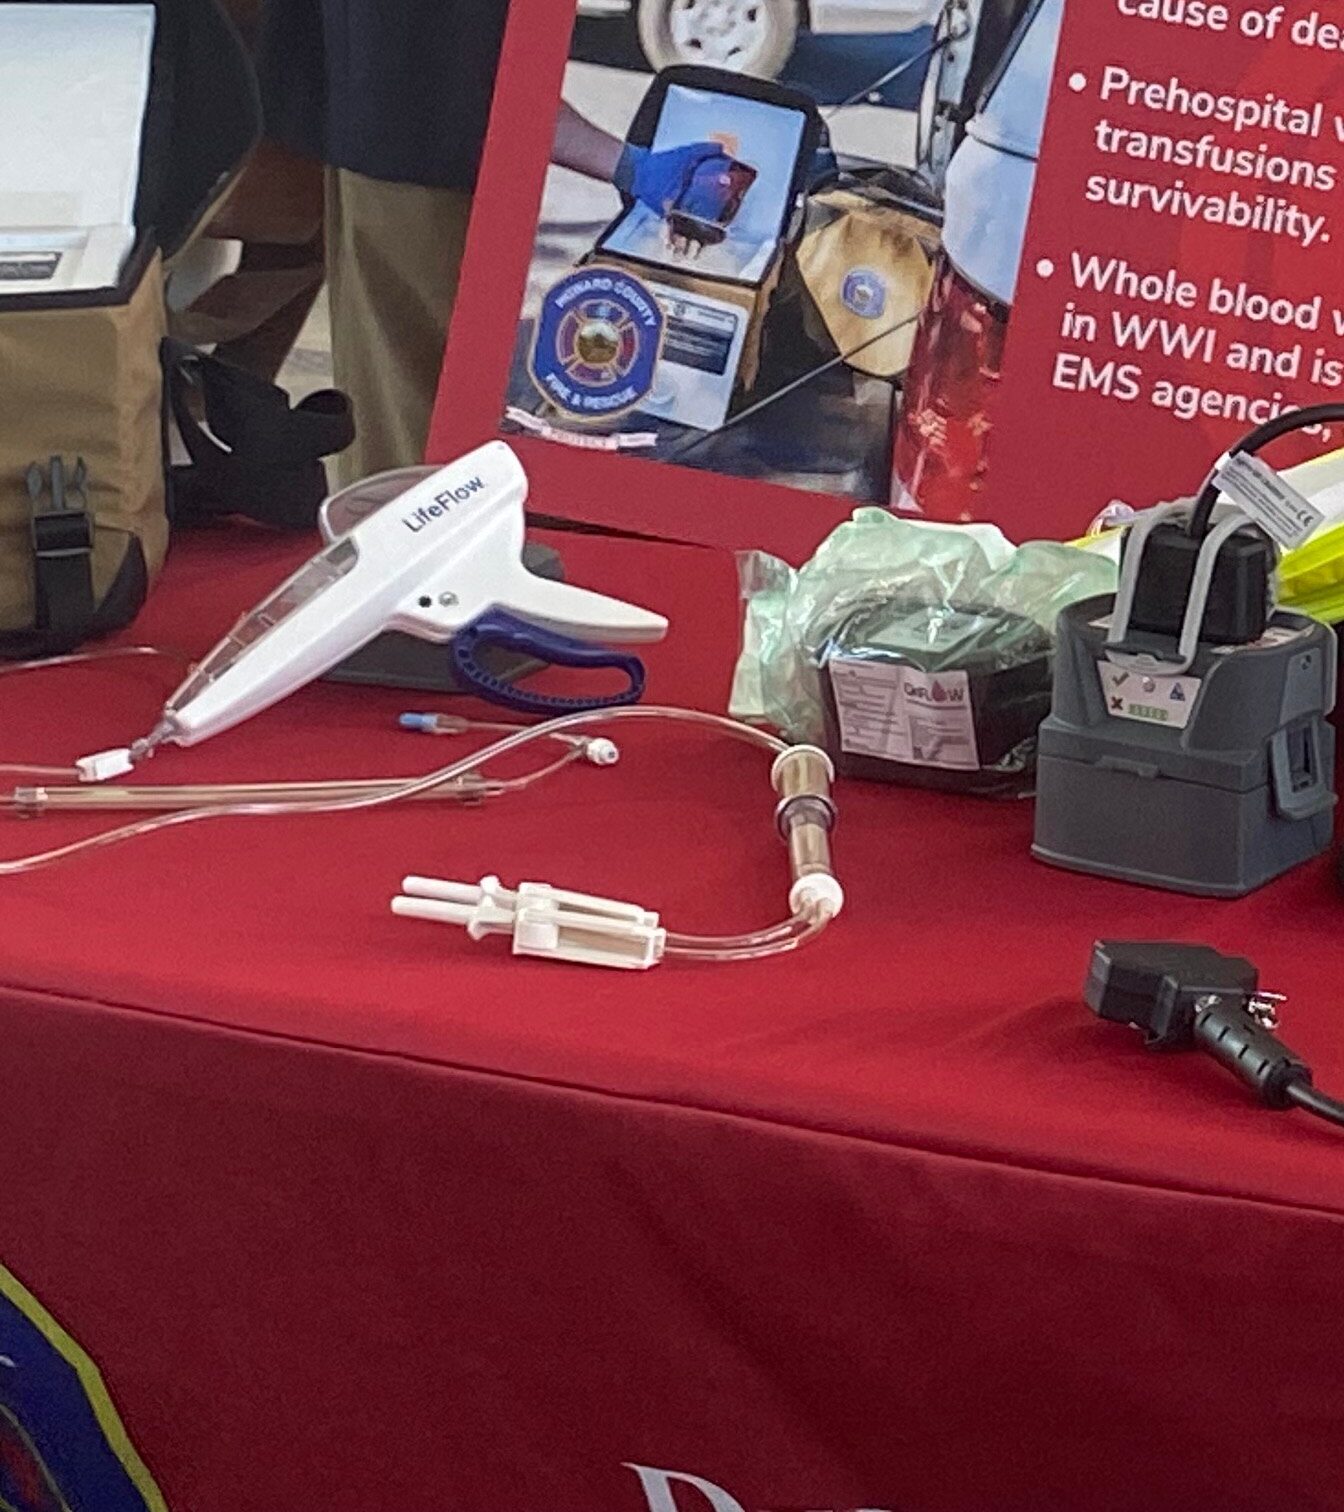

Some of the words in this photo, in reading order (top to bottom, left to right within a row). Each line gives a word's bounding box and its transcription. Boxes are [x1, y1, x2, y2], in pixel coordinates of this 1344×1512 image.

[1241, 6, 1284, 38] of
[1101, 67, 1322, 136] Prehospital
[1095, 120, 1336, 190] transfusions
[1086, 176, 1329, 246] survivability.
[1072, 252, 1196, 307] Whole
[1209, 279, 1321, 329] blood
[1054, 353, 1141, 399] EMS
[1062, 303, 1096, 341] in
[1113, 312, 1215, 362] WWI
[1227, 344, 1301, 378] and
[1312, 349, 1343, 386] is
[402, 475, 486, 533] LifeFlow
